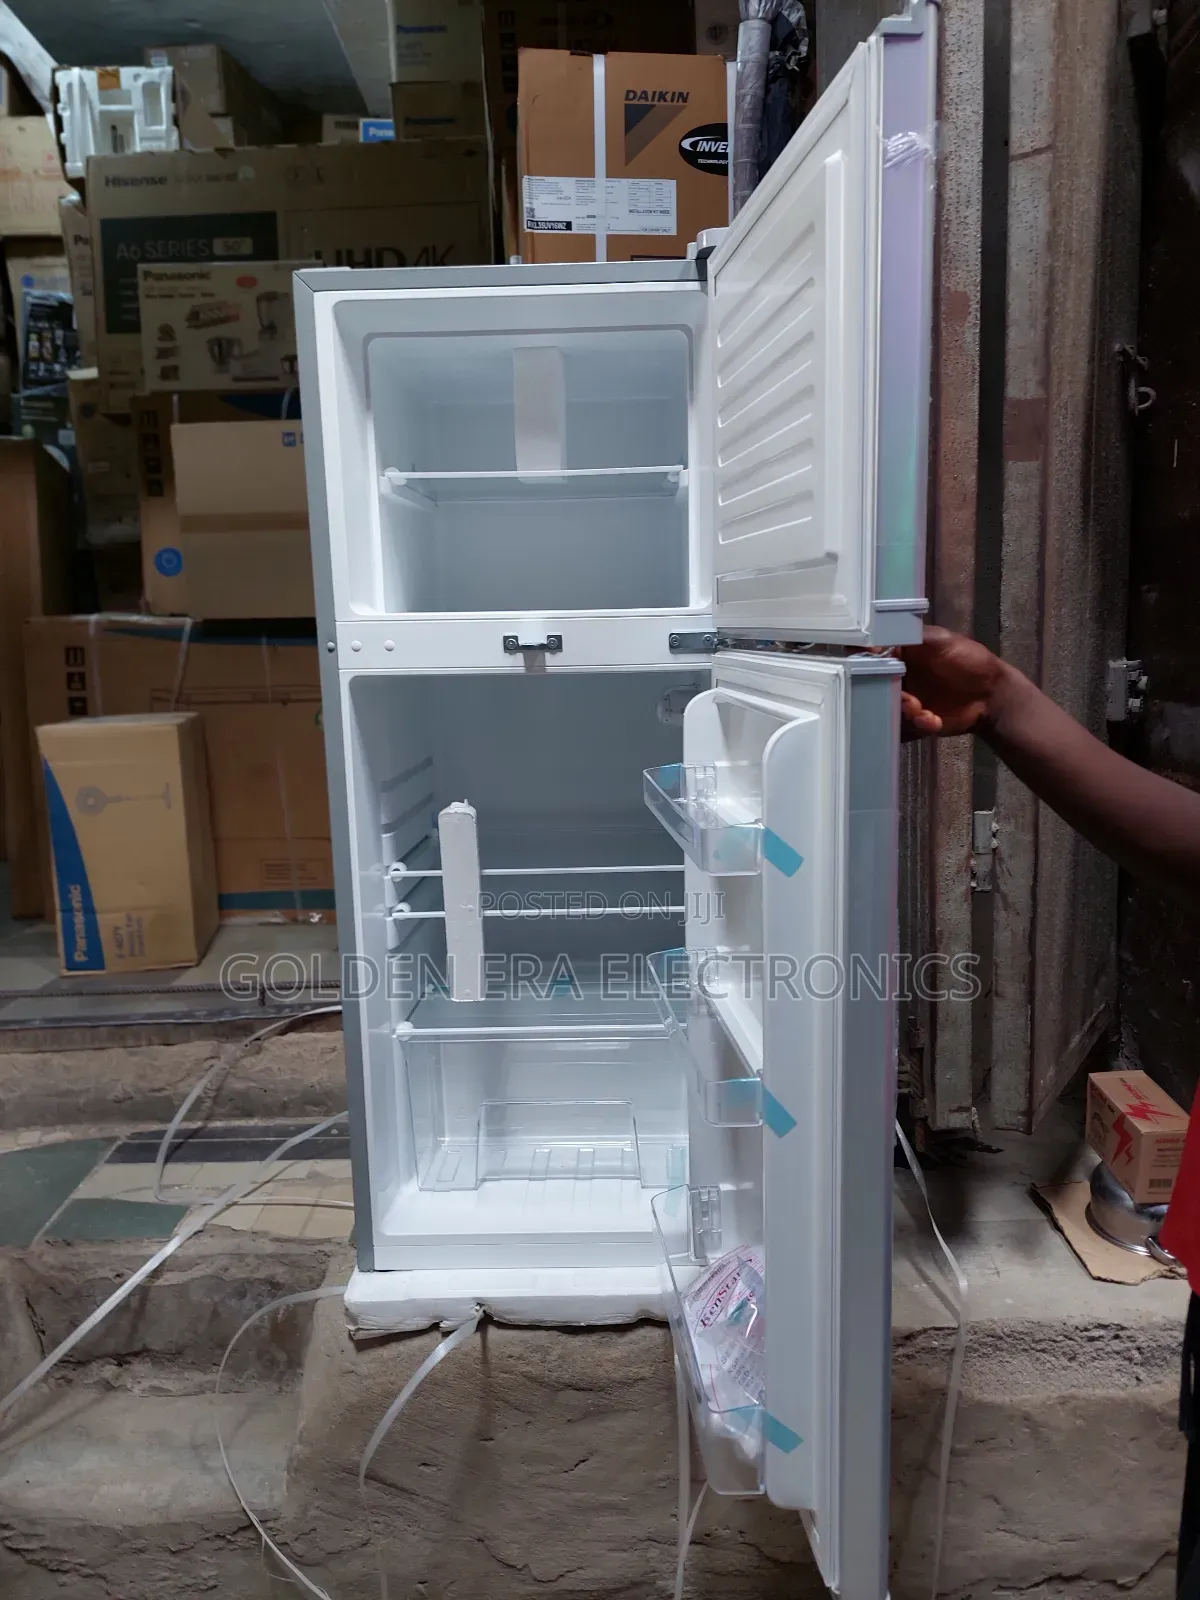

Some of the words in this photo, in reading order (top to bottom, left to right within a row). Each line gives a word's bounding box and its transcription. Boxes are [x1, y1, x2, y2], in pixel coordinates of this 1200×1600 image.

[624, 89, 690, 104] DAIKIN
[696, 140, 729, 153] INVE
[104, 174, 168, 188] Hisense
[116, 241, 142, 260] A6
[144, 239, 210, 259] SERIES
[143, 270, 212, 281] Panasonic
[69, 884, 89, 961] Panasonic
